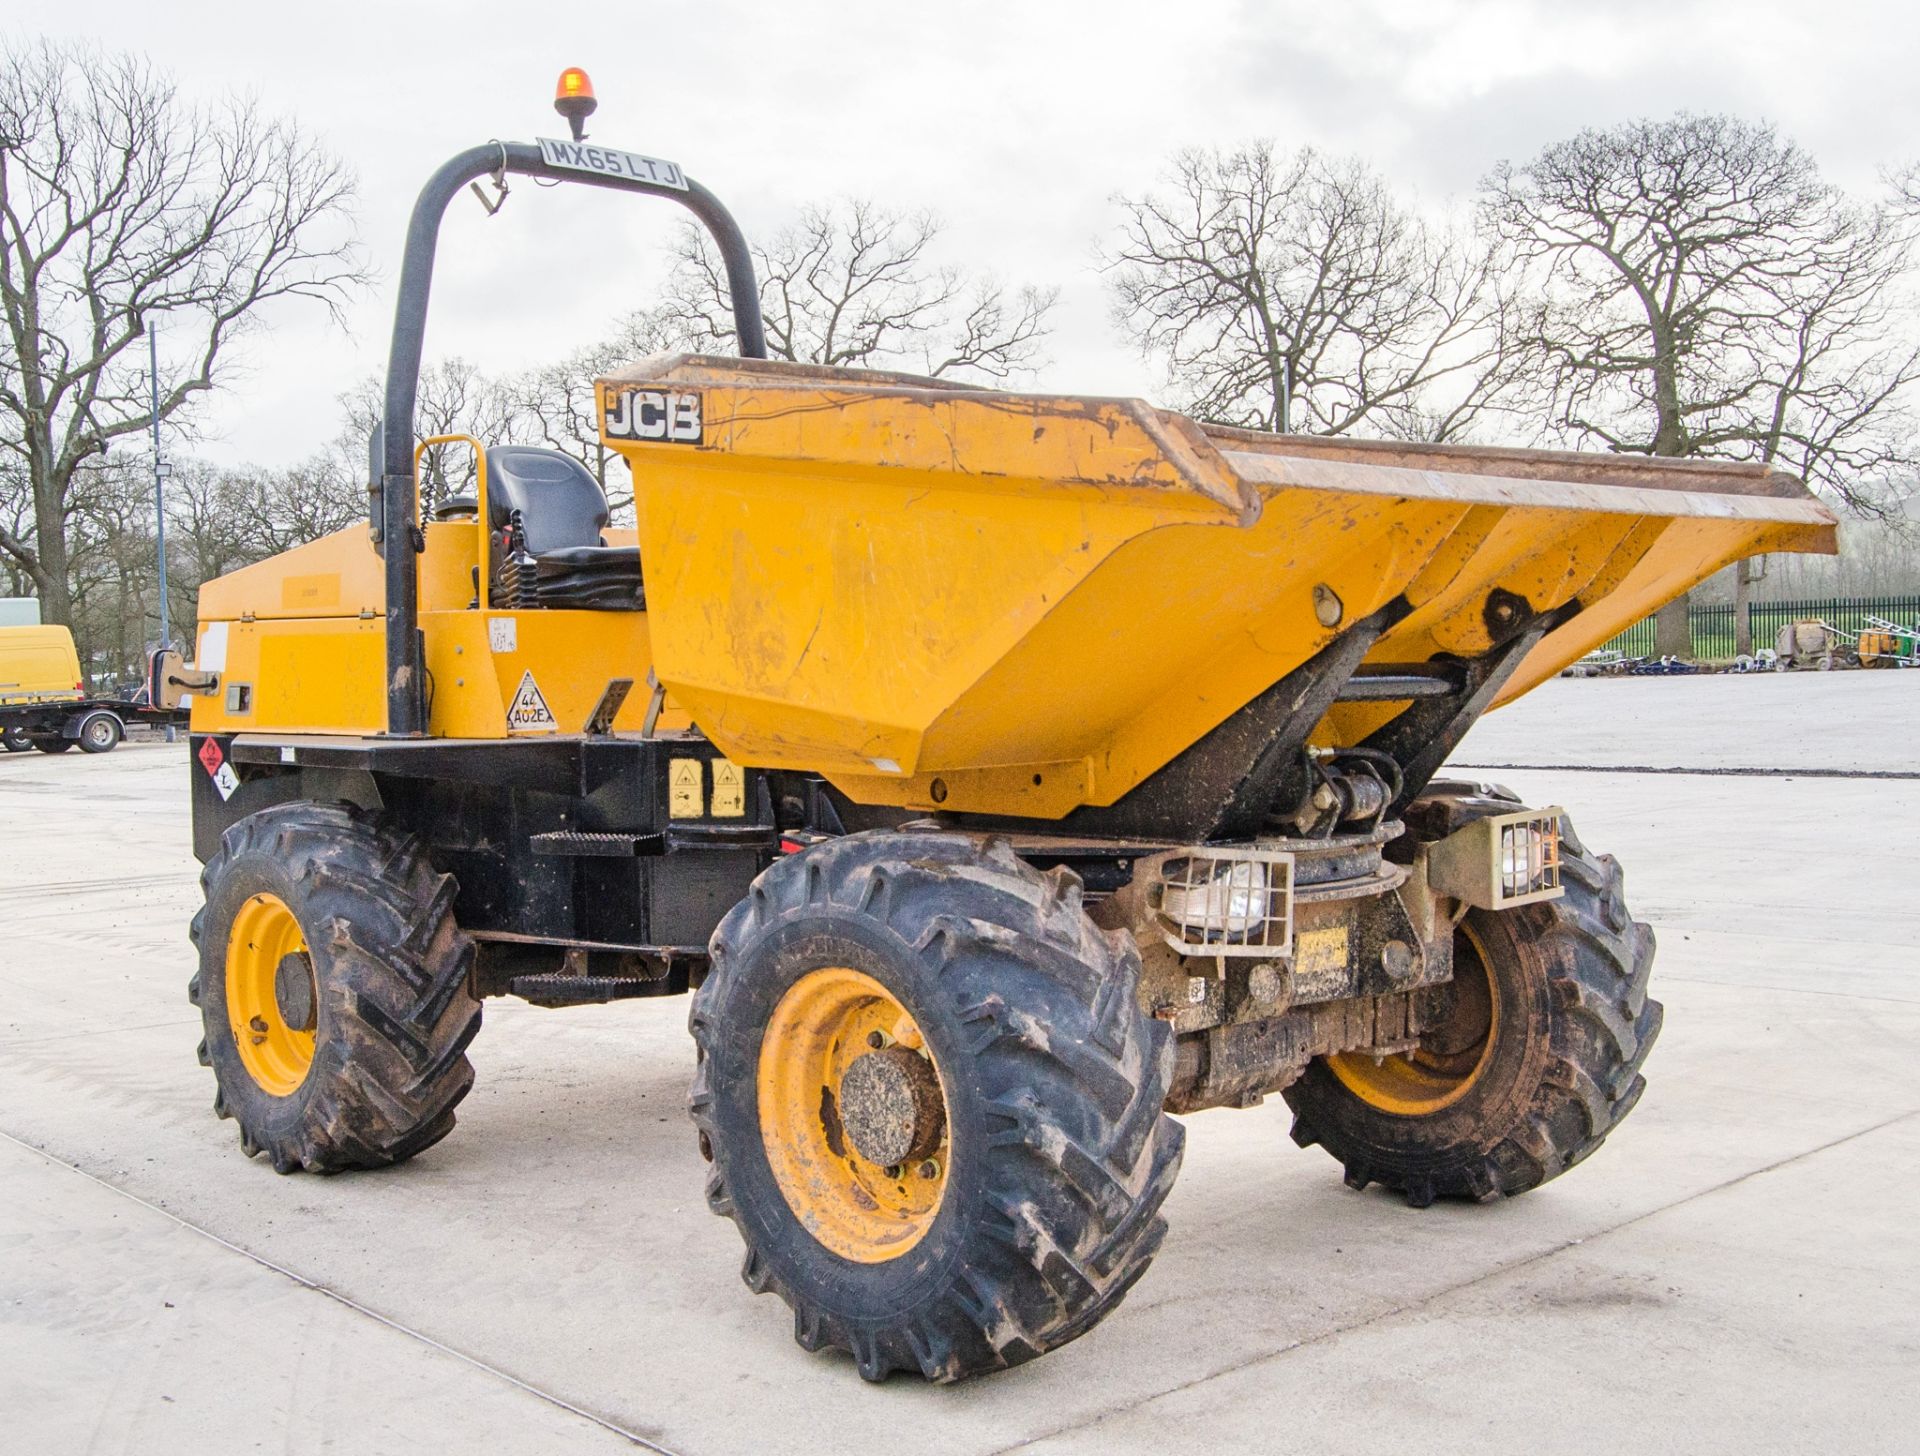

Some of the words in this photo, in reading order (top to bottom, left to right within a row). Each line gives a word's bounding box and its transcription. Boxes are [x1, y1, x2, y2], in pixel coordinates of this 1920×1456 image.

[550, 141, 623, 173] MX65
[625, 155, 677, 185] LTJ
[606, 391, 701, 440] JCB
